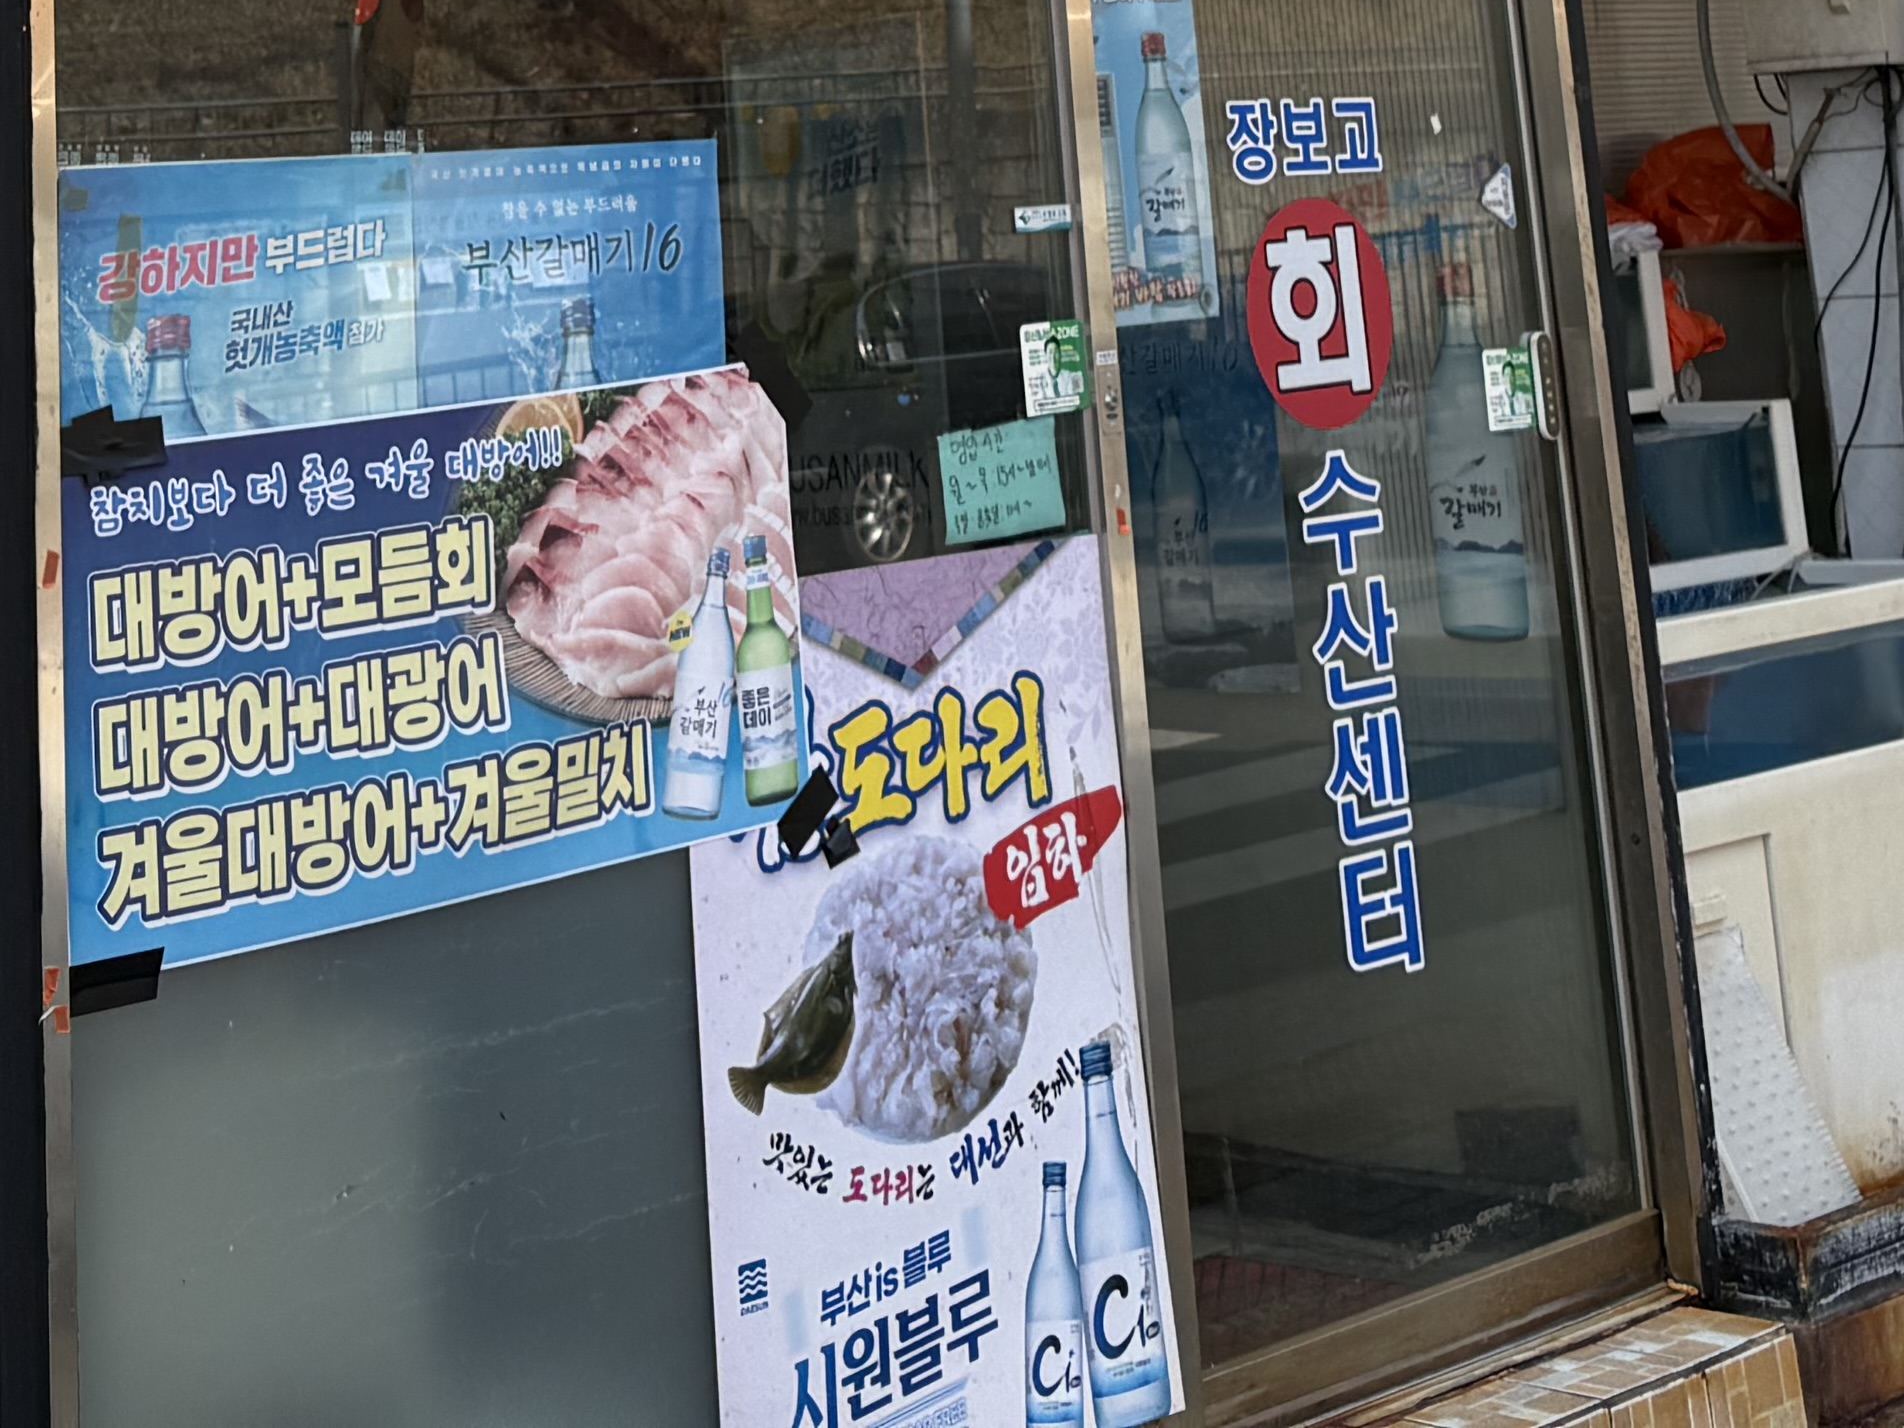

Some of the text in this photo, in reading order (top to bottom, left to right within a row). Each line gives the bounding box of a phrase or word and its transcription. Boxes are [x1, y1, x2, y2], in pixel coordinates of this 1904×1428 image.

[1227, 96, 1382, 184] 장보고
[97, 219, 386, 304] 강하지만 부드럽다
[1265, 223, 1373, 394] 회
[225, 319, 384, 374] 헛개농축액 첨가
[230, 300, 294, 334] 국내산
[90, 425, 564, 537] 참치보다 더 좋은 겨울 대방어!!
[91, 516, 494, 668] 대방어+모듬회
[95, 634, 507, 797] 대방어+대광어
[680, 715, 717, 740] 갈매기
[693, 698, 717, 718] 부산
[742, 686, 770, 708] 좋은
[743, 706, 772, 729] 데이
[1298, 449, 1424, 974] 수산센터
[830, 672, 1051, 836] 도다리
[99, 721, 650, 923] 겨울대방어+겨울밀치
[763, 1131, 834, 1195] 맛있는
[842, 1162, 936, 1206] 도다리는
[949, 1110, 1025, 1186] 대선과
[792, 1268, 999, 1428] 시원블루
